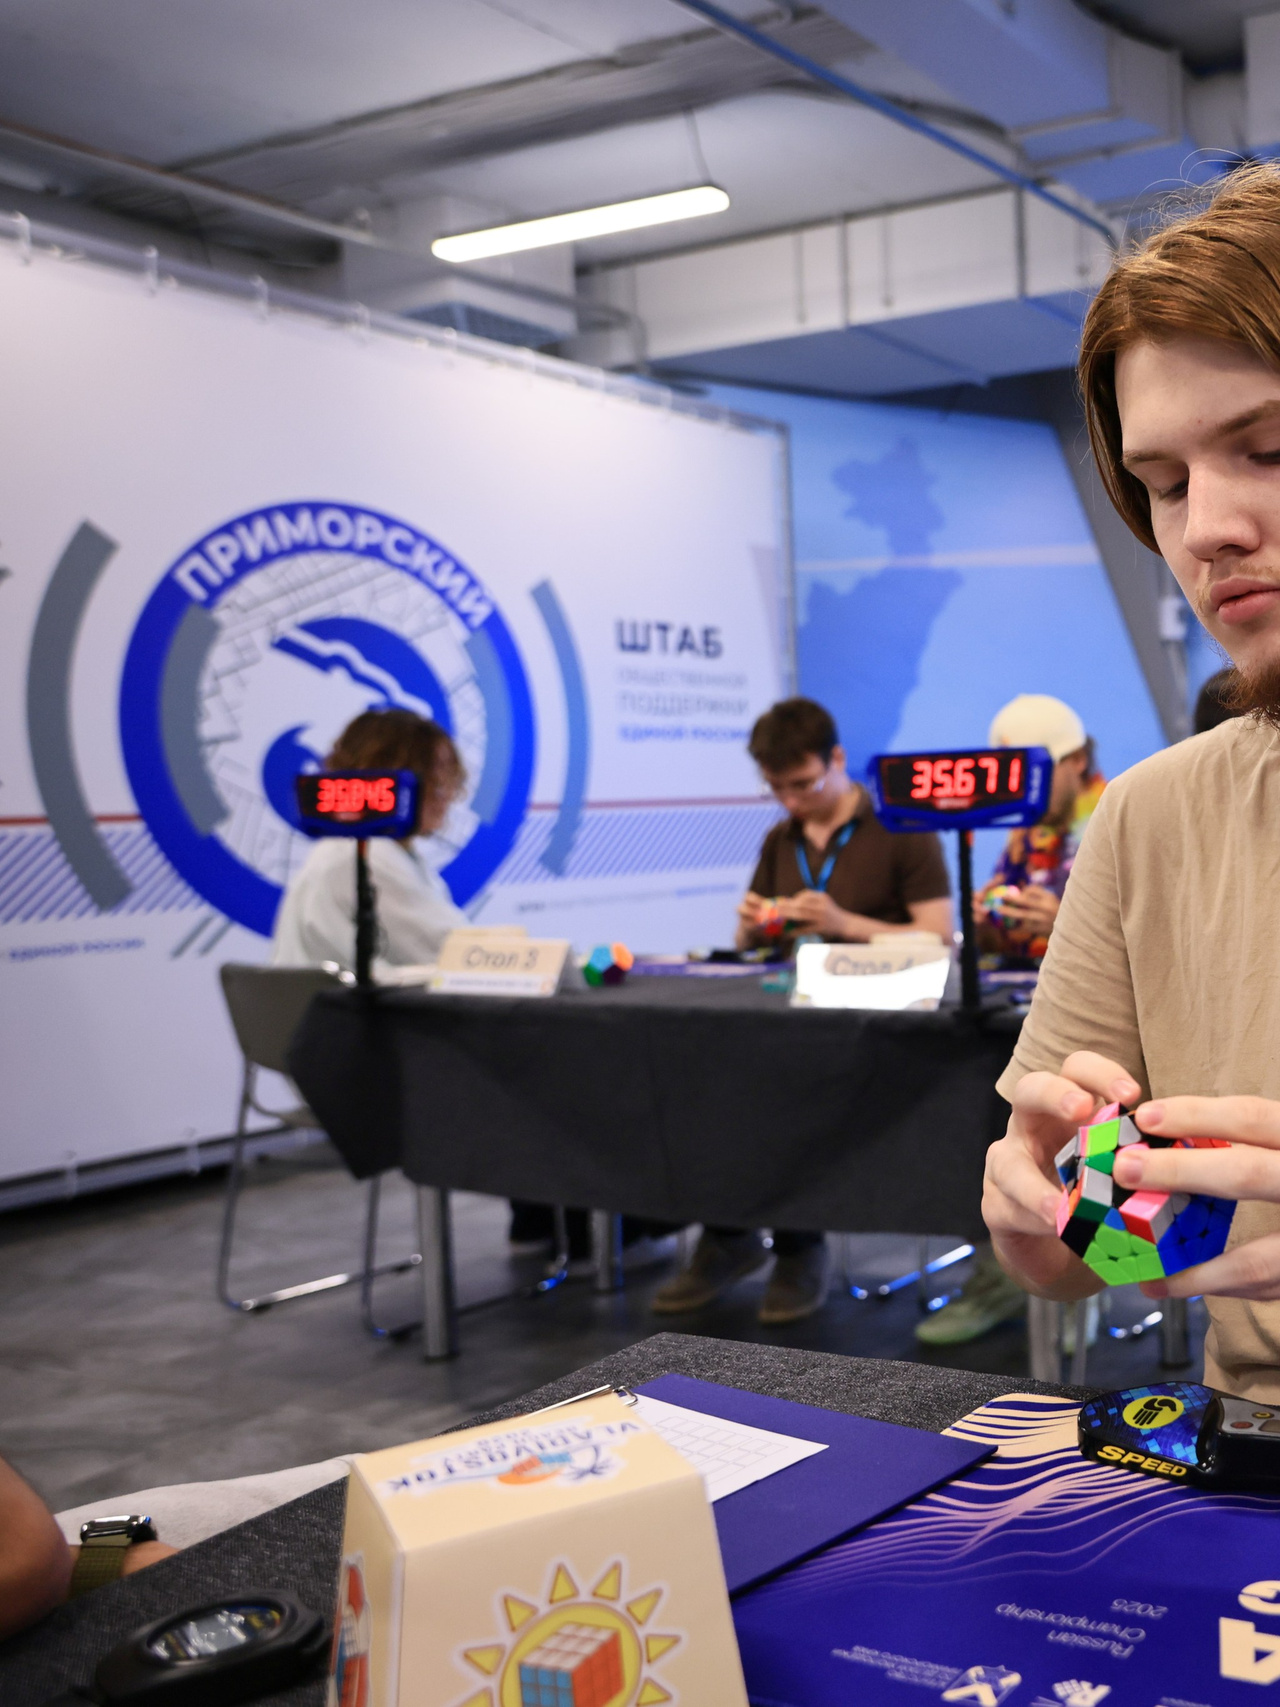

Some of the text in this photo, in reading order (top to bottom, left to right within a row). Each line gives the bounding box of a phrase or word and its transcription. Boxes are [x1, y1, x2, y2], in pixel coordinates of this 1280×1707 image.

[172, 507, 496, 628] ПРИМОРСКИЙ
[616, 619, 724, 659] ШТАБ
[464, 945, 519, 969] Стол
[1096, 1445, 1188, 1478] SPEED
[995, 1602, 1146, 1642] Championship
[1110, 1598, 1168, 1627] 2025
[1047, 1629, 1134, 1659] Russian
